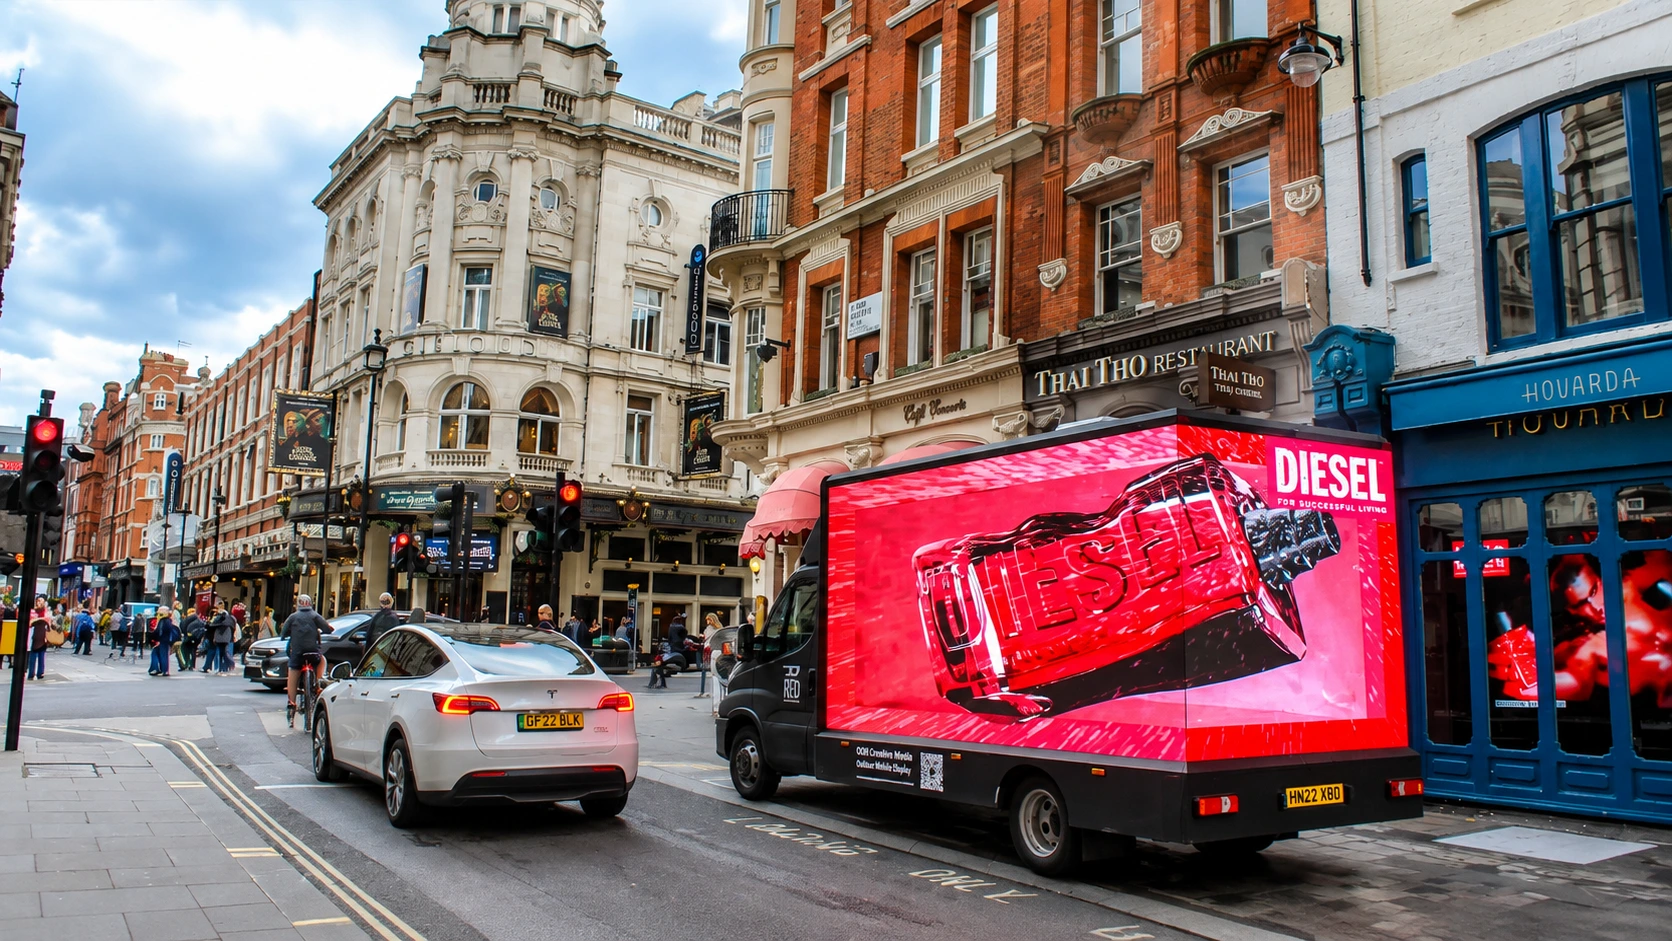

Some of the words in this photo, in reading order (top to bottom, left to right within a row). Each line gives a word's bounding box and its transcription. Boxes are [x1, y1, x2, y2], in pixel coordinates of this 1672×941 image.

[1035, 366, 1091, 397] THAI
[1095, 354, 1148, 385] THO
[1210, 366, 1239, 383] THAI
[1241, 371, 1265, 388] THO
[1274, 446, 1387, 502] DIESEL
[1277, 498, 1296, 507] FOR
[1299, 500, 1356, 512] SUCCESSFUL
[1358, 505, 1388, 514] LIVING
[783, 678, 801, 699] RED
[526, 714, 557, 727] GF22
[560, 714, 581, 727] BLK
[1289, 789, 1317, 804] HN22
